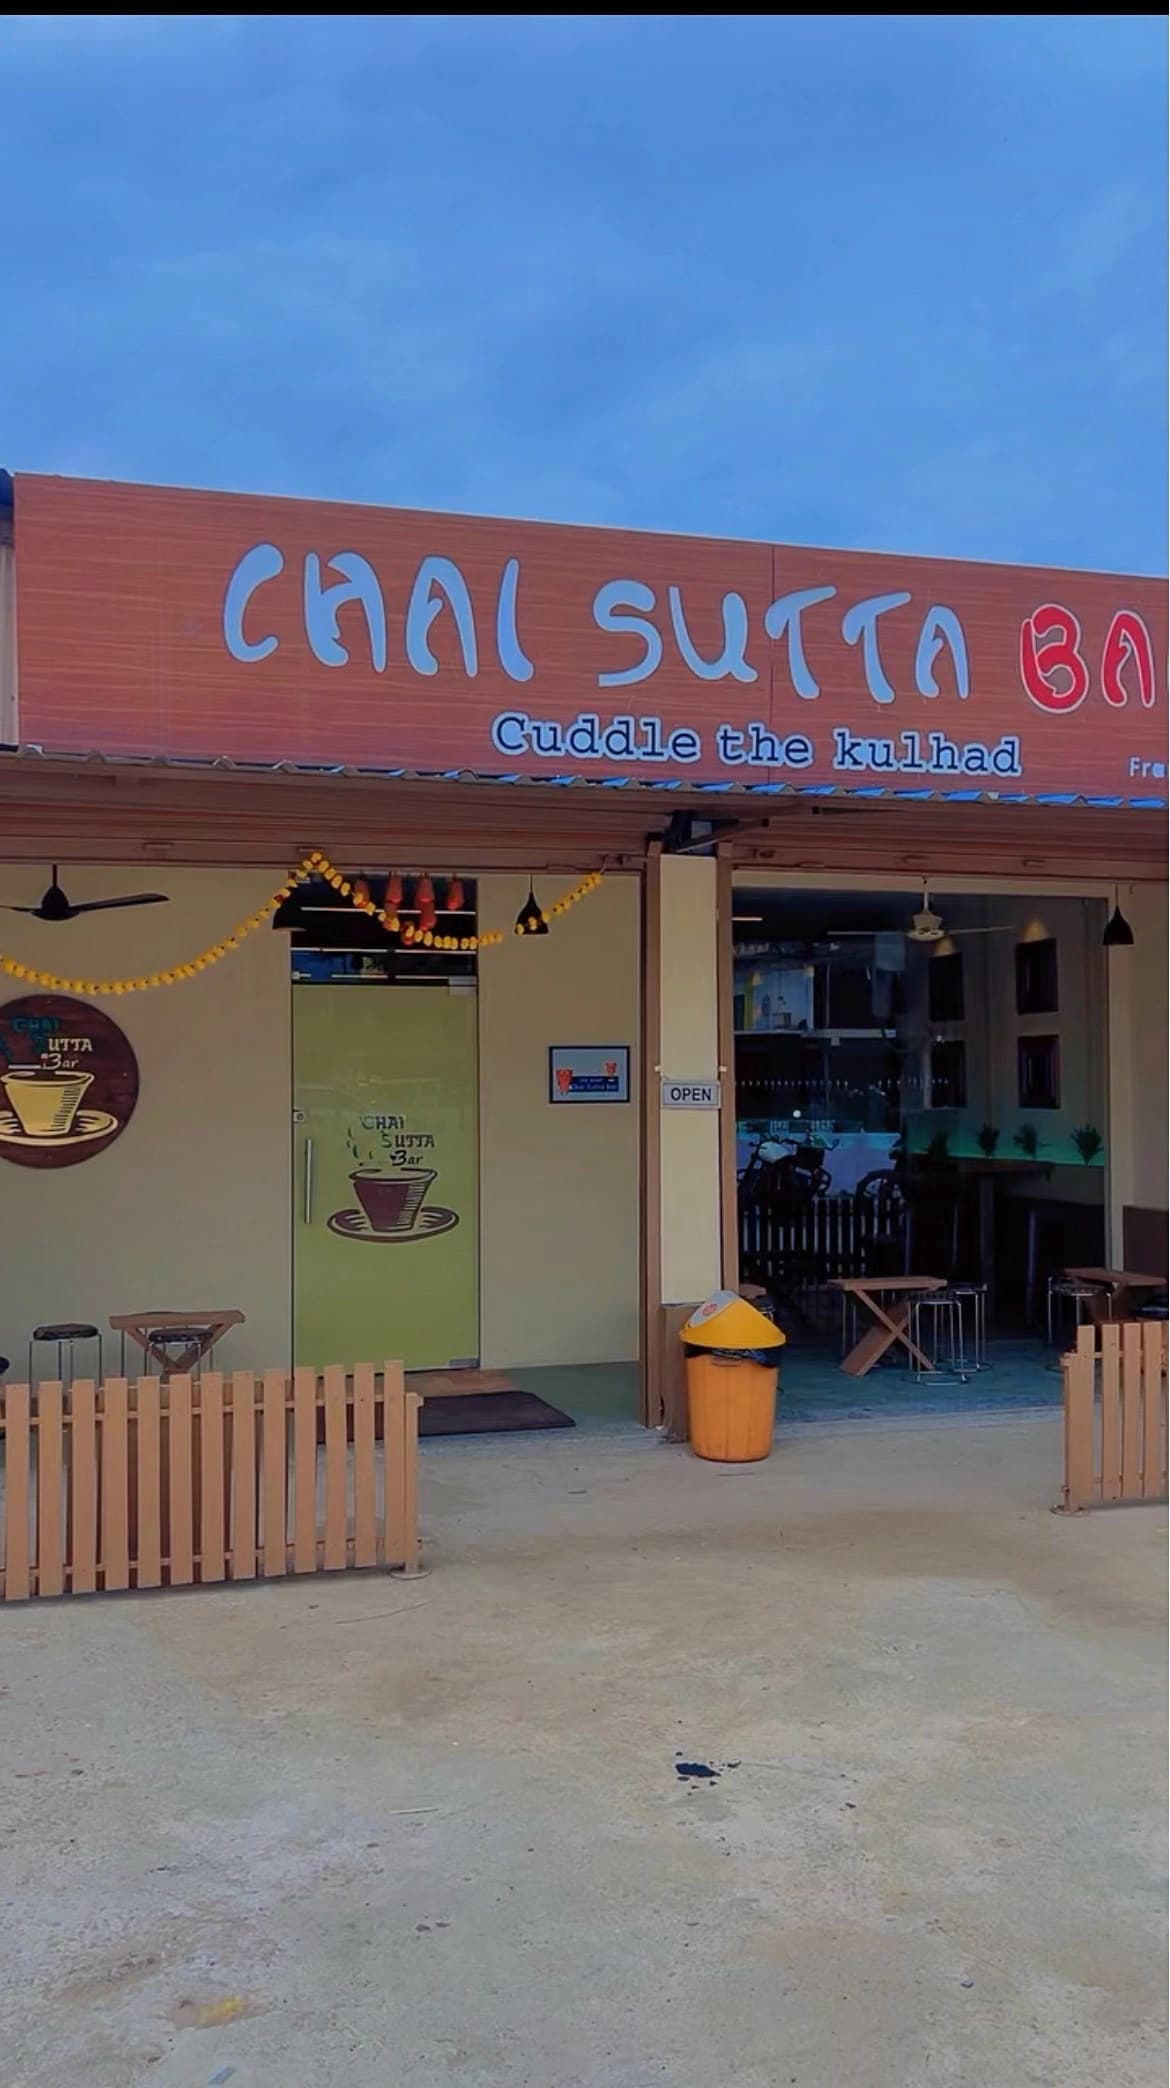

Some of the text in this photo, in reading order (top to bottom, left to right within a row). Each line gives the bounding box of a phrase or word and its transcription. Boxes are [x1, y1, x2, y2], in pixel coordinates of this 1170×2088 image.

[223, 542, 1168, 714] CHAI SUTTA BA
[491, 711, 1022, 779] Cuddle the kulhad
[671, 1087, 712, 1101] OPEN
[361, 1115, 404, 1129] CHAI
[380, 1132, 435, 1148] SUTTA
[390, 1150, 423, 1166] Bar
